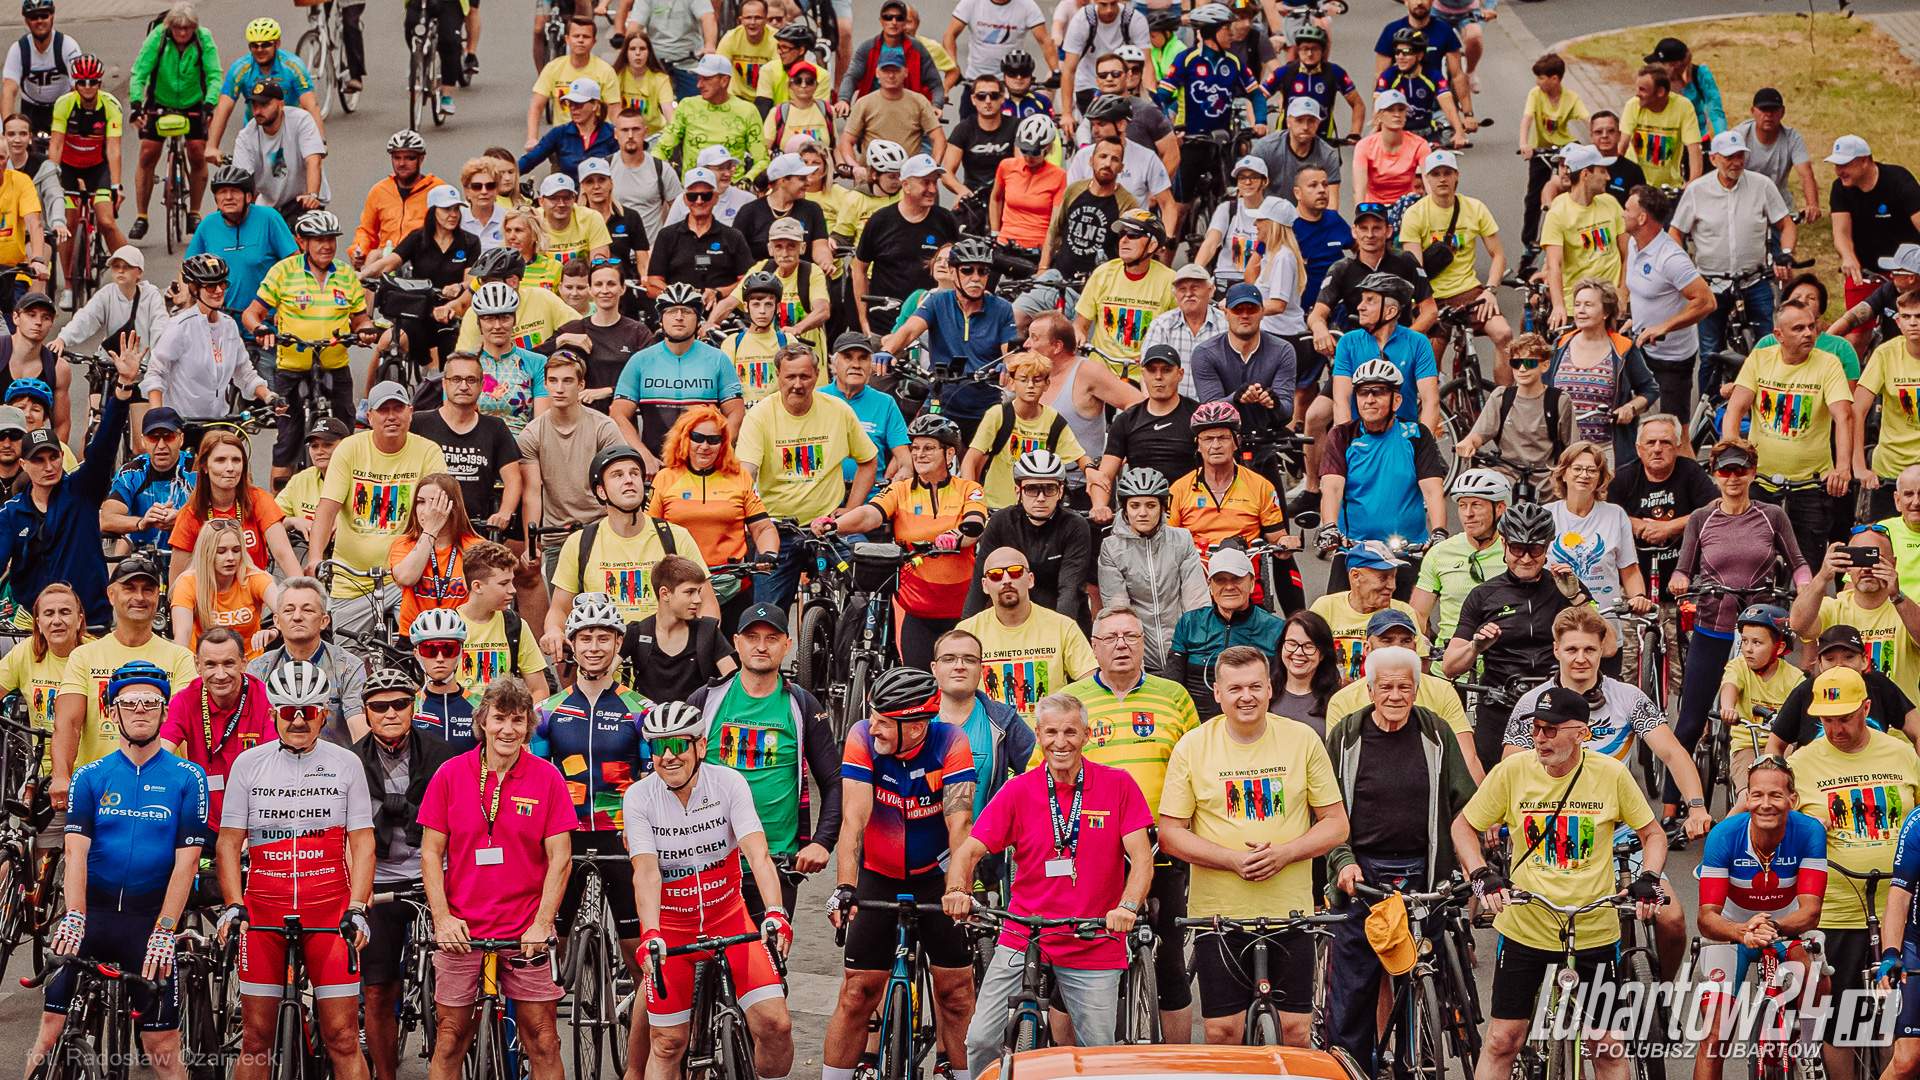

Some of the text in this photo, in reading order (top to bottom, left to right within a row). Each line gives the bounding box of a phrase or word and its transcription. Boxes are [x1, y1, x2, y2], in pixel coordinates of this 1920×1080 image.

[1068, 219, 1107, 243] VANS
[644, 377, 714, 390] DOLOMITI
[1024, 647, 1056, 657] ROWERU
[90, 668, 109, 676] XXXI
[597, 723, 619, 731] Luvi
[452, 729, 472, 737] Luvi
[1260, 766, 1287, 774] ROWERU
[1816, 778, 1837, 790] XXXI
[1871, 773, 1904, 782] ROWERU
[251, 787, 277, 797] STOK
[876, 789, 916, 810] LA VUELTA
[919, 796, 931, 807] 22
[907, 804, 943, 818] HOLANDA
[1569, 801, 1604, 810] ROWERU
[98, 806, 168, 820] Mostostal
[652, 826, 672, 837] STOK
[262, 849, 325, 861] TECH-DOM
[665, 876, 728, 897] TECH-DOM
